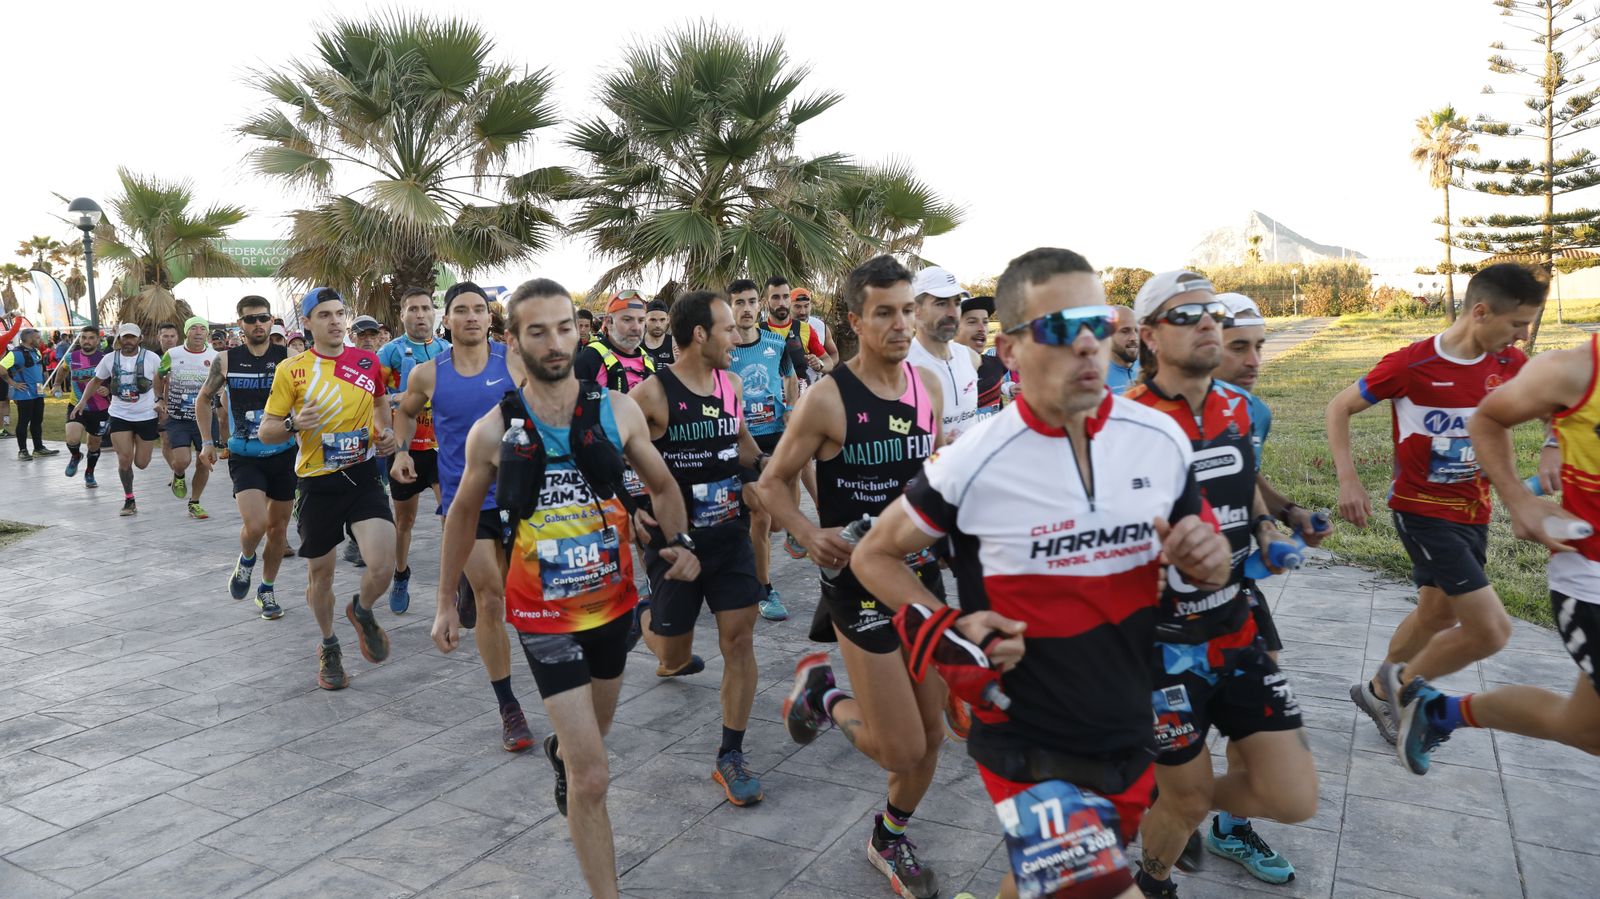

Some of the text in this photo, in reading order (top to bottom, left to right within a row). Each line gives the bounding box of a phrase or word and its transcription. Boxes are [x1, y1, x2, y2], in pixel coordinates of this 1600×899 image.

[242, 257, 257, 266] DE
[290, 369, 305, 379] VII
[229, 378, 259, 388] MEDIA
[751, 402, 763, 413] 80
[668, 420, 714, 441] MALDITO
[338, 436, 359, 450] 129
[663, 450, 713, 460] Portichuelo
[842, 438, 902, 465] MALDITO
[837, 478, 899, 491] Portichuelo
[851, 491, 887, 502] Alosno
[544, 512, 579, 523] Gabarras
[581, 510, 587, 518] &
[1030, 519, 1075, 537] CLUB
[1030, 522, 1155, 559] HARMAN
[564, 542, 600, 568] 134
[1047, 555, 1089, 569] TRAIL
[553, 572, 599, 585] Carbonera
[600, 561, 618, 576] 2023
[1021, 845, 1085, 874] Carbonera
